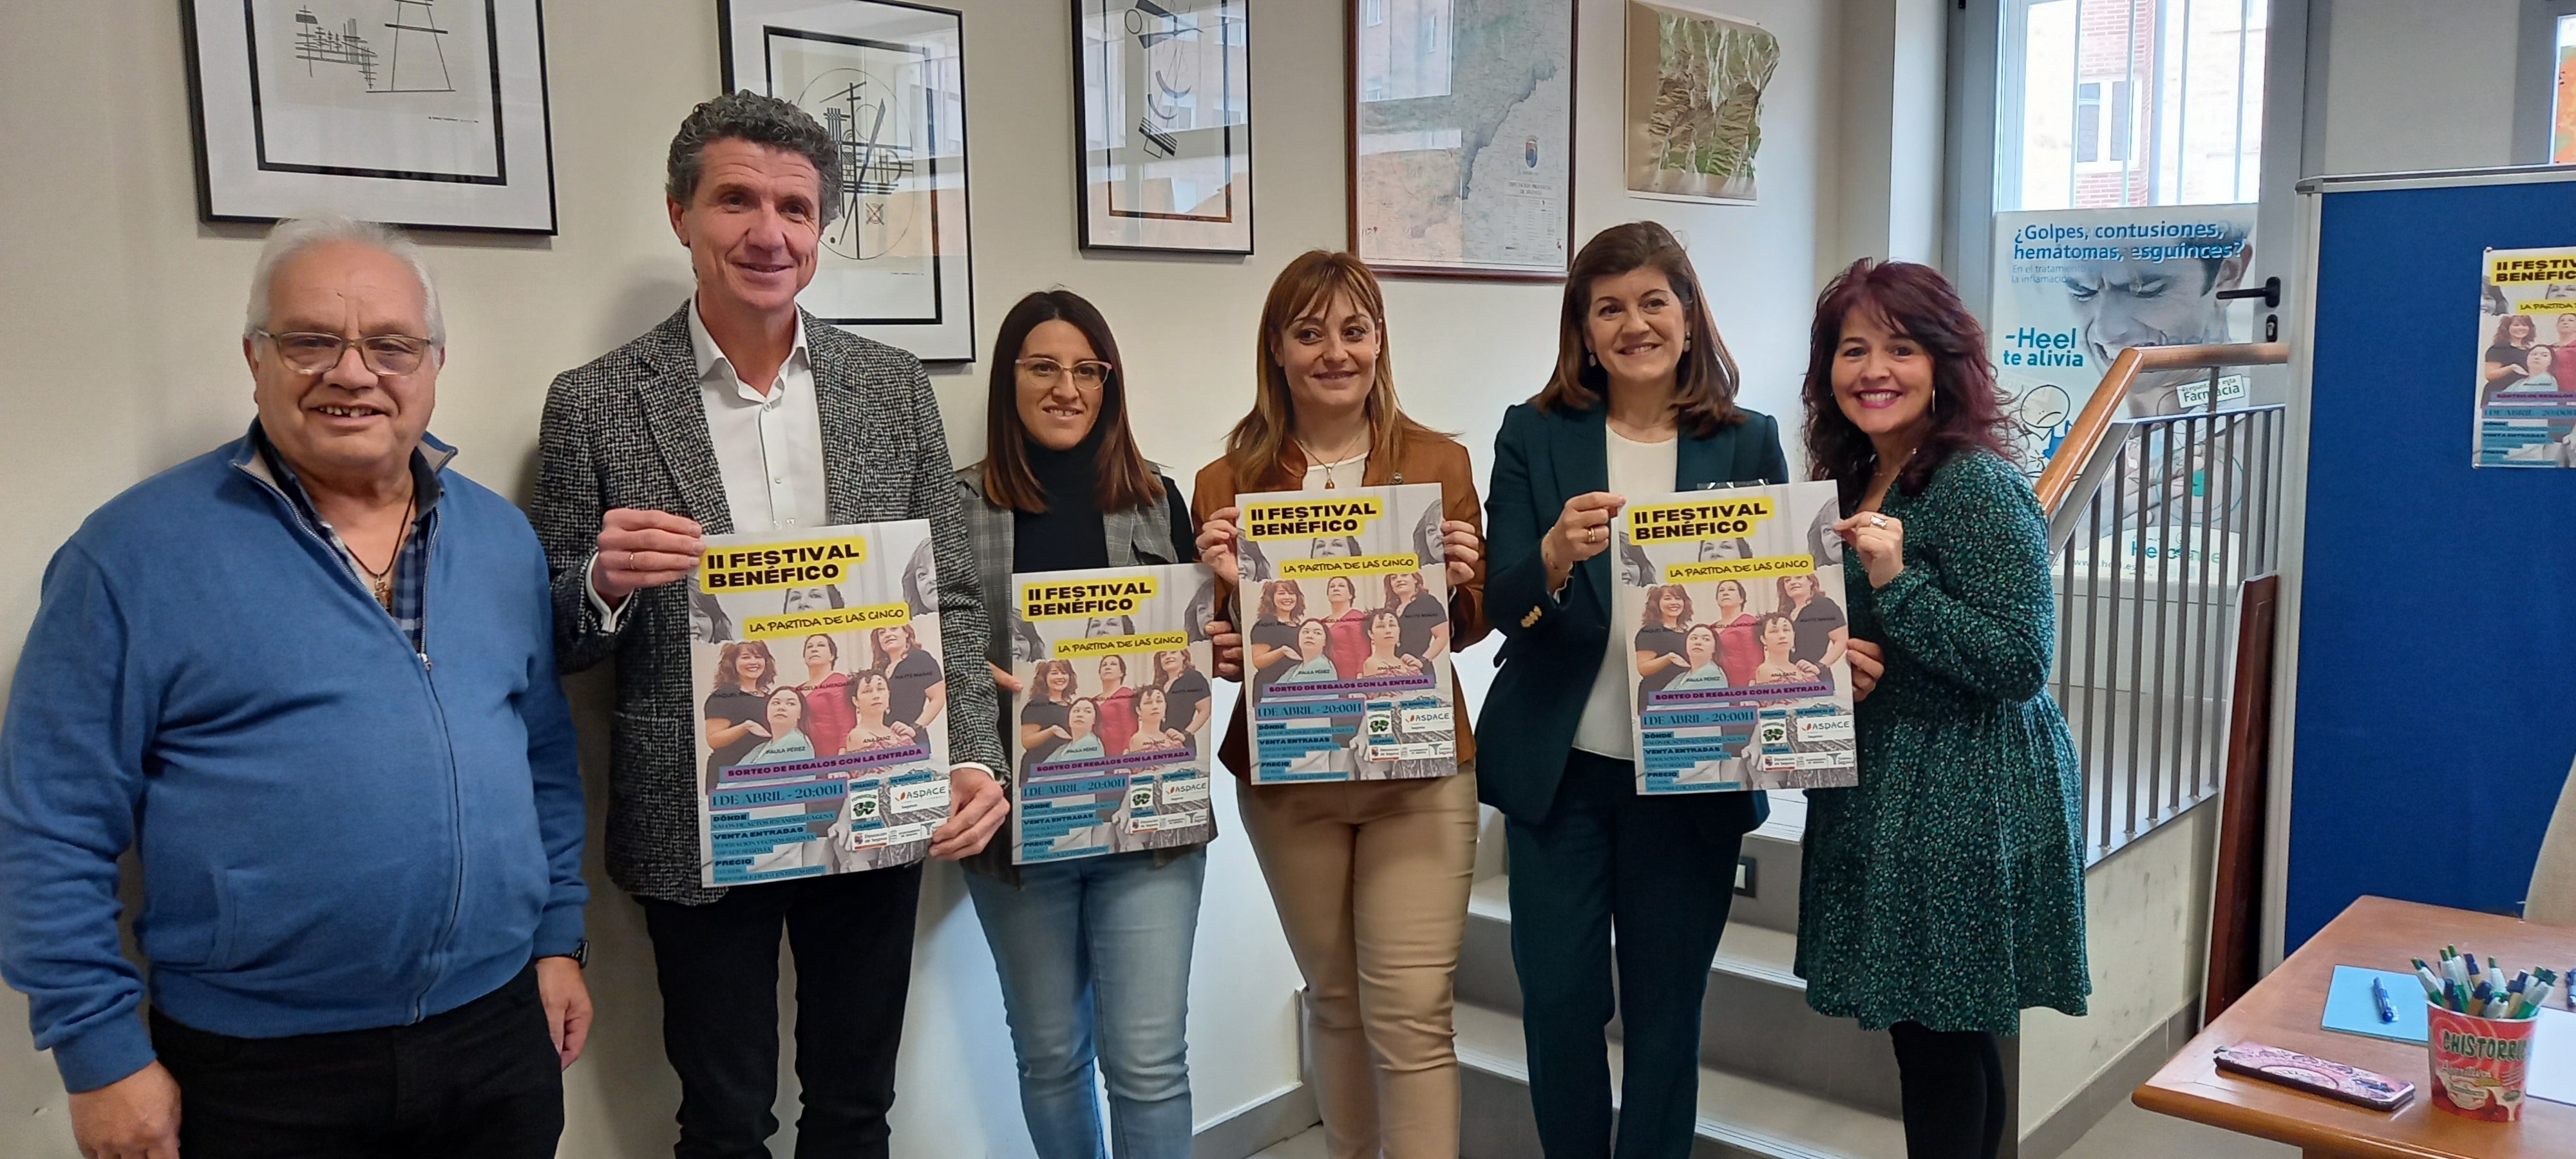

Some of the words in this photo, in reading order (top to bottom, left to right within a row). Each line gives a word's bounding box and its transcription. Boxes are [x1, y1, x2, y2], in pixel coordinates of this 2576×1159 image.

[2014, 223, 2090, 244] ¿Golpes,
[2094, 220, 2226, 240] contusiones,
[2014, 245, 2125, 262] hematomas,
[2131, 240, 2246, 264] esguinces?
[2012, 265, 2023, 273] En
[2035, 265, 2086, 273] tratamiento
[2496, 261, 2507, 270] II
[2005, 327, 2077, 349] -Heel
[2003, 350, 2022, 366] te
[2027, 350, 2084, 367] alivia
[1251, 509, 1263, 521] II
[1268, 502, 1375, 519] FESTIVAL
[1634, 511, 1647, 524] II
[1652, 502, 1766, 522] FESTIVAL
[1251, 516, 1356, 536] BENÉFICO
[1634, 517, 1747, 540] BENÉFICO
[707, 554, 723, 569] II
[728, 544, 858, 566] FESTIVAL
[1284, 565, 1296, 574] LA
[1298, 563, 1341, 573] PARTIDA
[1361, 560, 1379, 568] LAS
[1381, 557, 1412, 565] CINCO
[708, 561, 839, 588] BENÉFICO
[1670, 569, 1683, 578] LA
[1685, 566, 1732, 577] PARTIDA
[1752, 561, 1772, 570] LAS
[1773, 558, 1808, 568] CINCO
[1028, 589, 1040, 601] II
[1046, 581, 1150, 599] FESTIVAL
[1028, 596, 1131, 616] BENÉFICO
[750, 623, 765, 634] LA
[767, 618, 821, 632] PARTIDA
[824, 615, 843, 625] DE
[844, 612, 866, 622] LAS
[866, 607, 903, 619] CINCO
[1059, 645, 1070, 654] LA
[1072, 642, 1115, 652] PARTIDA
[1134, 637, 1150, 646] LAS
[1152, 634, 1182, 644] CINCO
[1388, 677, 1428, 686] ENTRADA
[1655, 692, 1691, 701] SORTEO
[1705, 689, 1748, 698] REGALOS
[1783, 684, 1826, 693] ENTRADA
[1263, 707, 1277, 716] DE
[1282, 705, 1313, 715] ABRIL
[1321, 702, 1361, 713] 20:00H
[1649, 715, 1664, 725] DE
[1669, 713, 1703, 724] ABRIL
[1711, 711, 1754, 722] 20:00H
[728, 766, 771, 778] SORTEO
[773, 764, 787, 773] DE
[788, 759, 837, 771] REGALOS
[838, 756, 861, 765] CON
[876, 748, 922, 760] ENTRADA
[1037, 763, 1070, 772] SORTEO
[1083, 757, 1121, 768] REGALOS
[1153, 750, 1189, 760] ENTRADA
[719, 794, 737, 806] DE
[744, 789, 784, 804] ABRIL
[795, 783, 843, 799] 20:00H
[713, 812, 746, 823] DÓNDE
[1023, 818, 1050, 826] VENTA
[1052, 813, 1094, 822] ENTRADAS
[714, 831, 748, 842] VENTA
[750, 825, 803, 838] ENTRADAS
[1024, 839, 1052, 847] PRECIO
[715, 856, 752, 867] PRECIO
